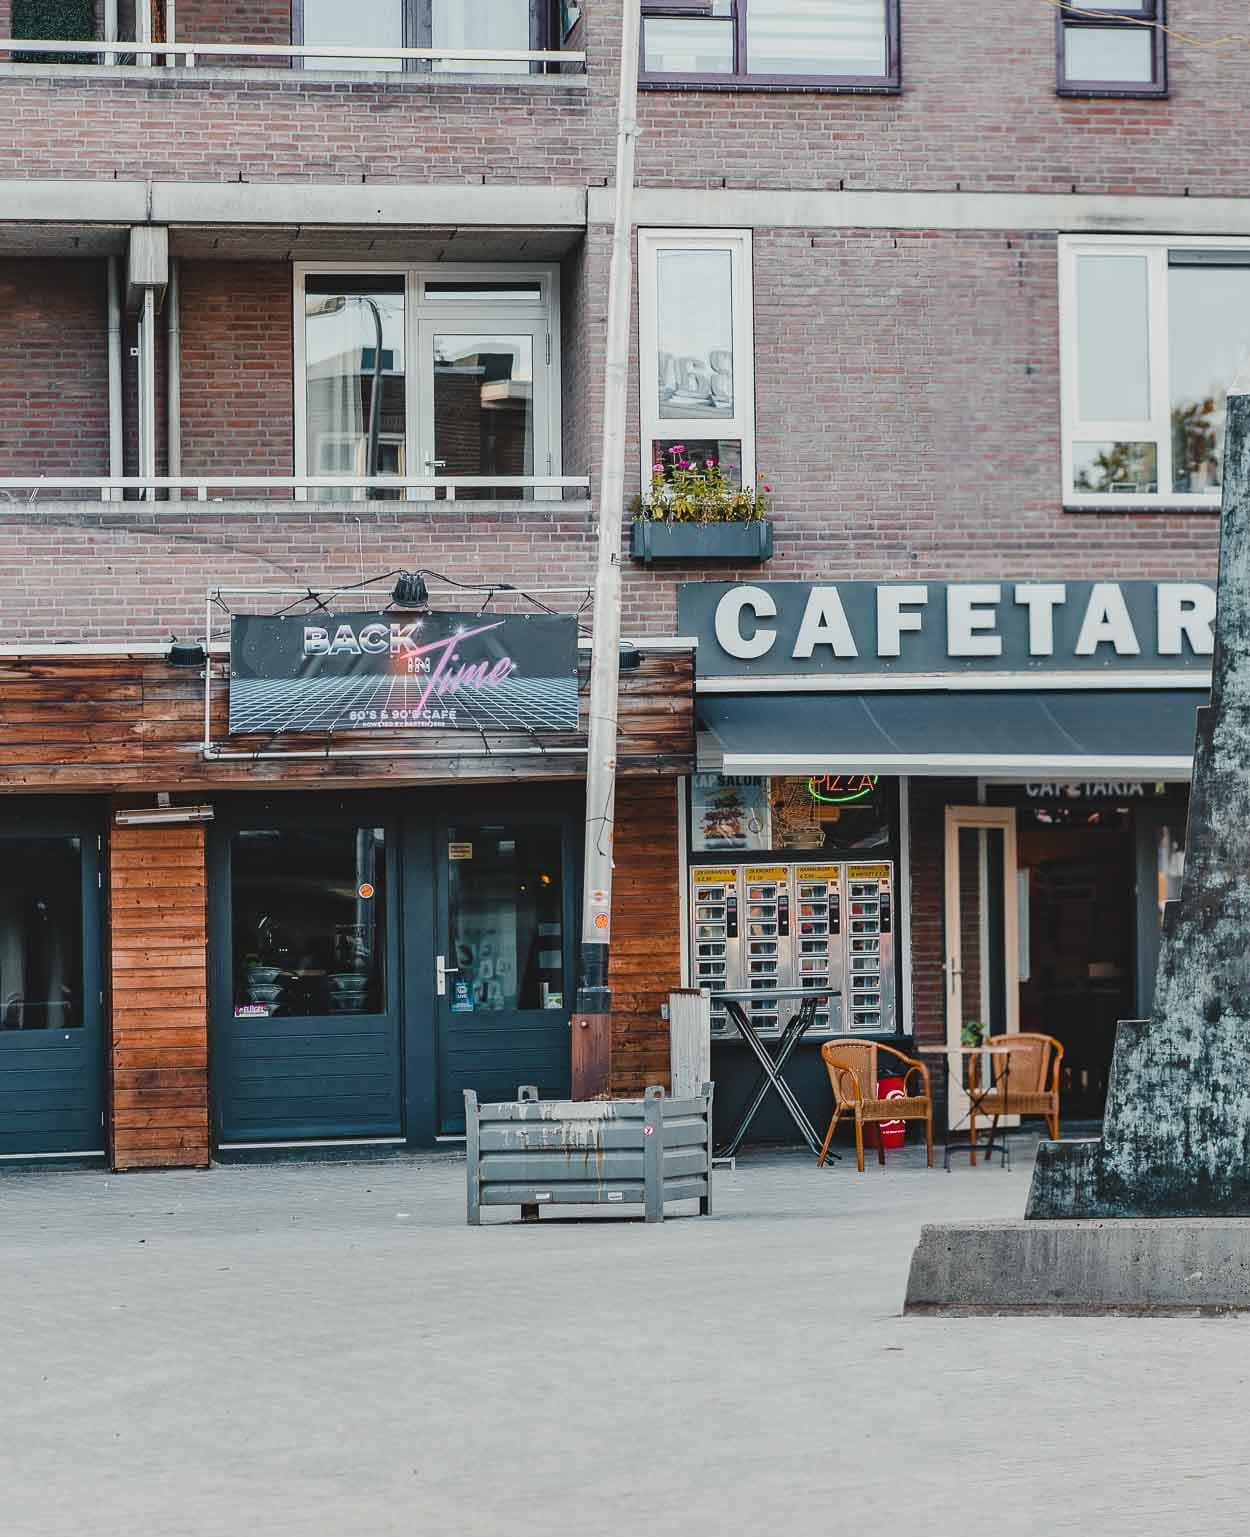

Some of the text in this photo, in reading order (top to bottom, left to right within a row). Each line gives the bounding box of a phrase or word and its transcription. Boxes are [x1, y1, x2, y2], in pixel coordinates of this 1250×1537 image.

[303, 623, 420, 656] BACK
[400, 620, 513, 713] Time
[407, 656, 431, 673] IN
[422, 707, 457, 720] CAFÉ
